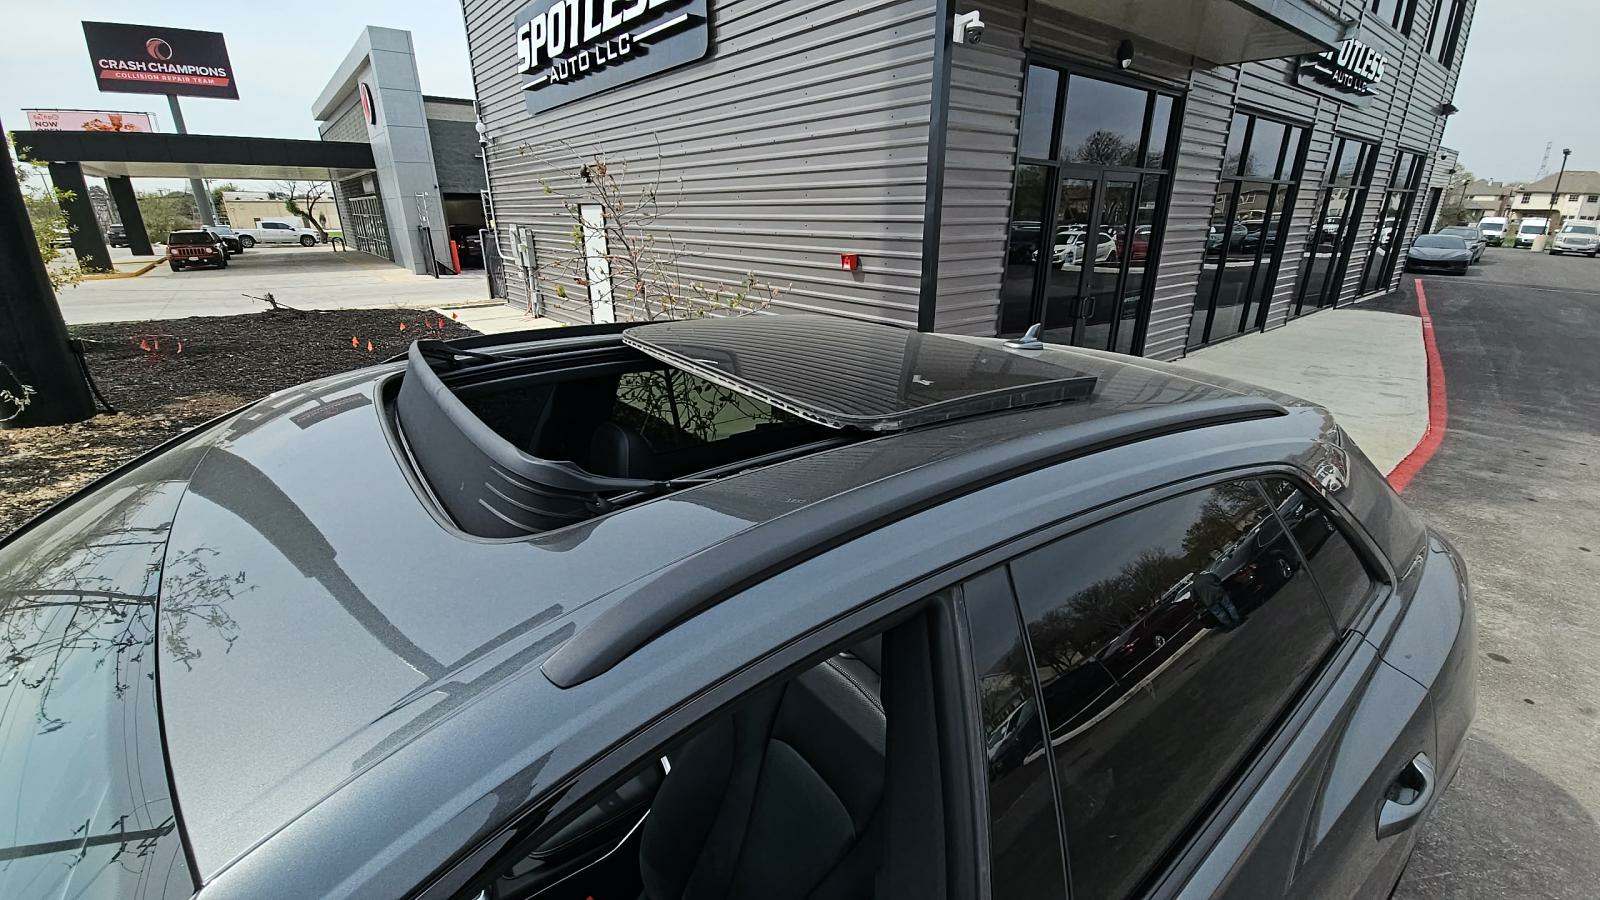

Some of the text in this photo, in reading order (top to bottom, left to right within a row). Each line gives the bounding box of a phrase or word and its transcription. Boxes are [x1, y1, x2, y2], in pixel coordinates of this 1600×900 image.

[550, 32, 631, 84] AUTO LLC
[98, 59, 227, 77] CRASH CHAMPIONS
[115, 72, 215, 85] COLLISION REPAIR TEAM
[1332, 69, 1354, 87] AUTO
